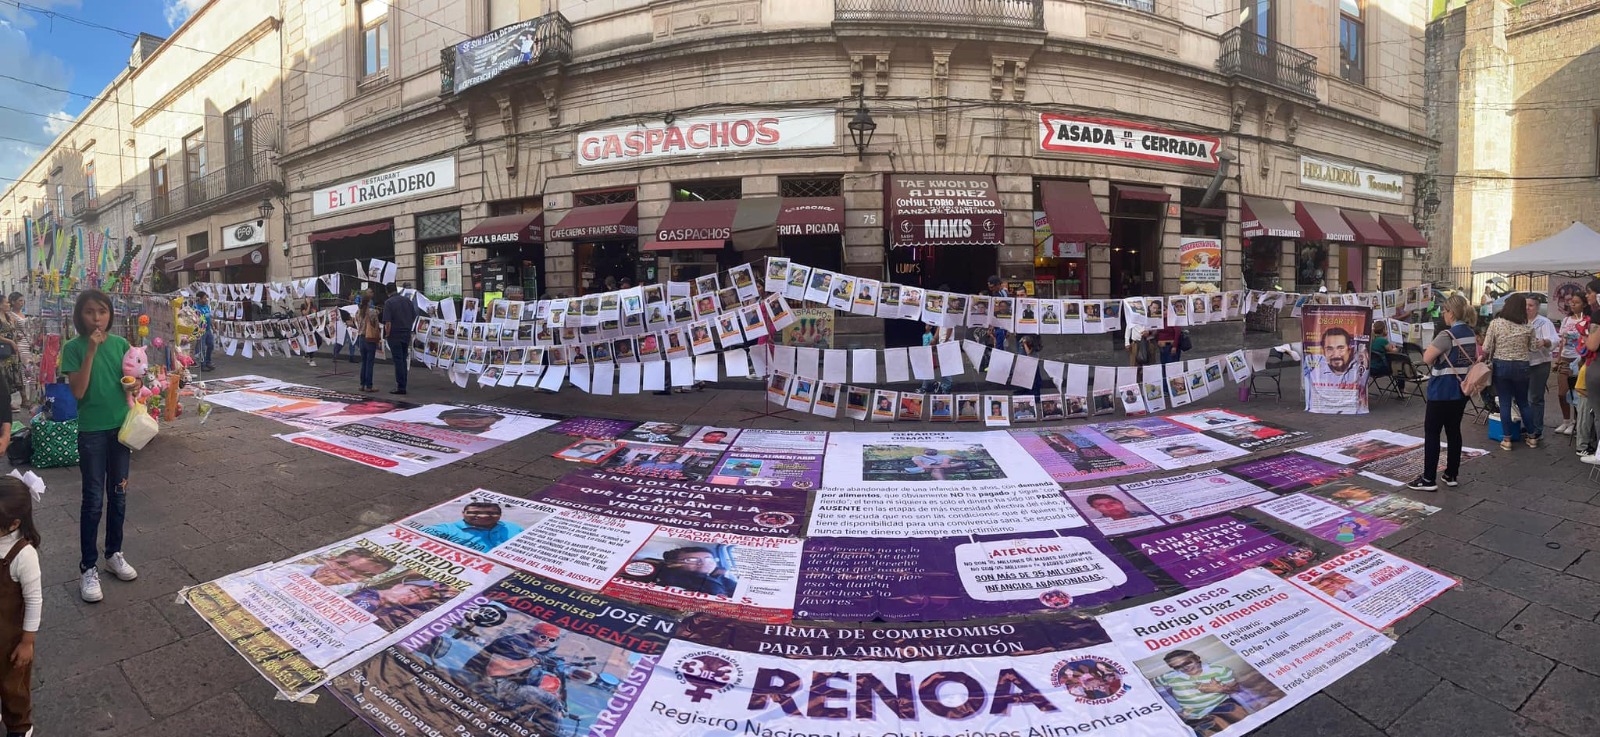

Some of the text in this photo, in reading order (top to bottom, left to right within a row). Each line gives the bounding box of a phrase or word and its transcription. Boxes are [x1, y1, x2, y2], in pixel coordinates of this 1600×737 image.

[579, 117, 781, 161] GASPACHOS
[1057, 124, 1208, 158] ASADA EN LA CERRADA
[361, 171, 402, 186] RESTAURANT
[897, 179, 989, 189] TAE KWON DO
[1302, 160, 1362, 187] HELADERÍA
[329, 170, 437, 209] EL TRAGADERO
[909, 189, 988, 198] AJEDREZ
[896, 197, 954, 208] CONSULTORIO
[588, 224, 618, 235] FRAPPES
[806, 223, 840, 234] PICADA
[863, 214, 877, 225] 75
[924, 218, 972, 239] MAKIS
[463, 235, 484, 245] PIZZA
[484, 235, 490, 243] &
[491, 232, 520, 243] BAGUIS
[659, 227, 731, 241] GASPACHOS
[609, 475, 634, 483] NO
[669, 483, 748, 495] ALCANZA
[752, 488, 774, 497] LA
[631, 486, 706, 501] JUSTICIA
[978, 490, 1010, 498] pagado
[1017, 481, 1054, 489] demanda
[475, 490, 557, 514] FELIZ CUMPLEAÑOS
[541, 497, 606, 512] DEUDORES
[602, 509, 703, 527] ALIMENTARIOS
[608, 499, 713, 519] VERGÜENZA
[616, 492, 649, 502] LOS
[650, 497, 733, 511] ALCANCE
[737, 505, 762, 513] LA
[949, 505, 991, 513] necesidad
[840, 518, 999, 529] disponibilidad convivencia
[948, 511, 999, 520] condiciones
[676, 532, 781, 549] PADRE AUSENTE
[715, 530, 799, 545] ALIMENTARIO
[844, 527, 869, 535] tiene
[870, 527, 902, 535] dinero
[911, 527, 949, 537] siempre
[964, 524, 1017, 536] victimismo.
[1147, 523, 1248, 556] ALIMENTARIO
[388, 527, 496, 575] SE BUSCA
[989, 544, 1063, 560] ¡ATENCIÓN!
[1140, 535, 1181, 550] A UN
[1174, 545, 1200, 556] NO
[1206, 538, 1224, 549] SE
[1225, 532, 1243, 542] LE
[386, 541, 468, 576] ALFREDO
[492, 549, 605, 587] FELIZ DEL PADRE AUSENTE
[1209, 560, 1227, 571] LE
[1297, 548, 1376, 583] SE BUSCA
[975, 564, 1090, 583] SON MÁS DE MILLONES
[1370, 564, 1411, 588] ALIMENTARIO
[514, 572, 543, 589] Hijo
[543, 581, 568, 596] del
[567, 588, 609, 608] Líder
[611, 577, 658, 591] José
[658, 584, 710, 600] Juan
[802, 589, 863, 597] derechos
[985, 582, 1034, 595] INFANCIAS
[319, 588, 371, 624] ALIMENTARIO
[499, 581, 599, 620] transportista
[800, 596, 855, 607] favores.
[1132, 582, 1277, 638] Rodrigo Díaz Tellez
[1149, 585, 1230, 617] Se busca
[312, 601, 352, 628] AUSENTE
[404, 596, 492, 653] MITOMANO
[597, 605, 676, 635] JOSÉ N
[1144, 591, 1291, 653] Deudor alimentario
[1239, 606, 1311, 643] Morelia Michoacán
[555, 615, 660, 655] AUSENTE!
[764, 623, 1016, 640] FIRMA DE COMPROMISO
[1220, 619, 1264, 642] Originario:
[757, 639, 1025, 660] PARA LA ARMONIZACIÓN
[1253, 626, 1333, 669] Infantiles abandonados
[1302, 628, 1356, 662] meses pagar
[349, 669, 370, 689] Sigo
[681, 659, 737, 685] 3 DE 3
[387, 646, 411, 667] Firme
[410, 660, 423, 674] un
[421, 666, 466, 701] convenio
[464, 692, 489, 715] para
[488, 707, 510, 727] que
[509, 719, 529, 735] me
[747, 667, 1062, 721] RENOA
[353, 693, 406, 737] la pensión.
[450, 699, 488, 730] cuál no
[650, 700, 738, 731] Registro
[1027, 702, 1163, 737] Alimentarias
